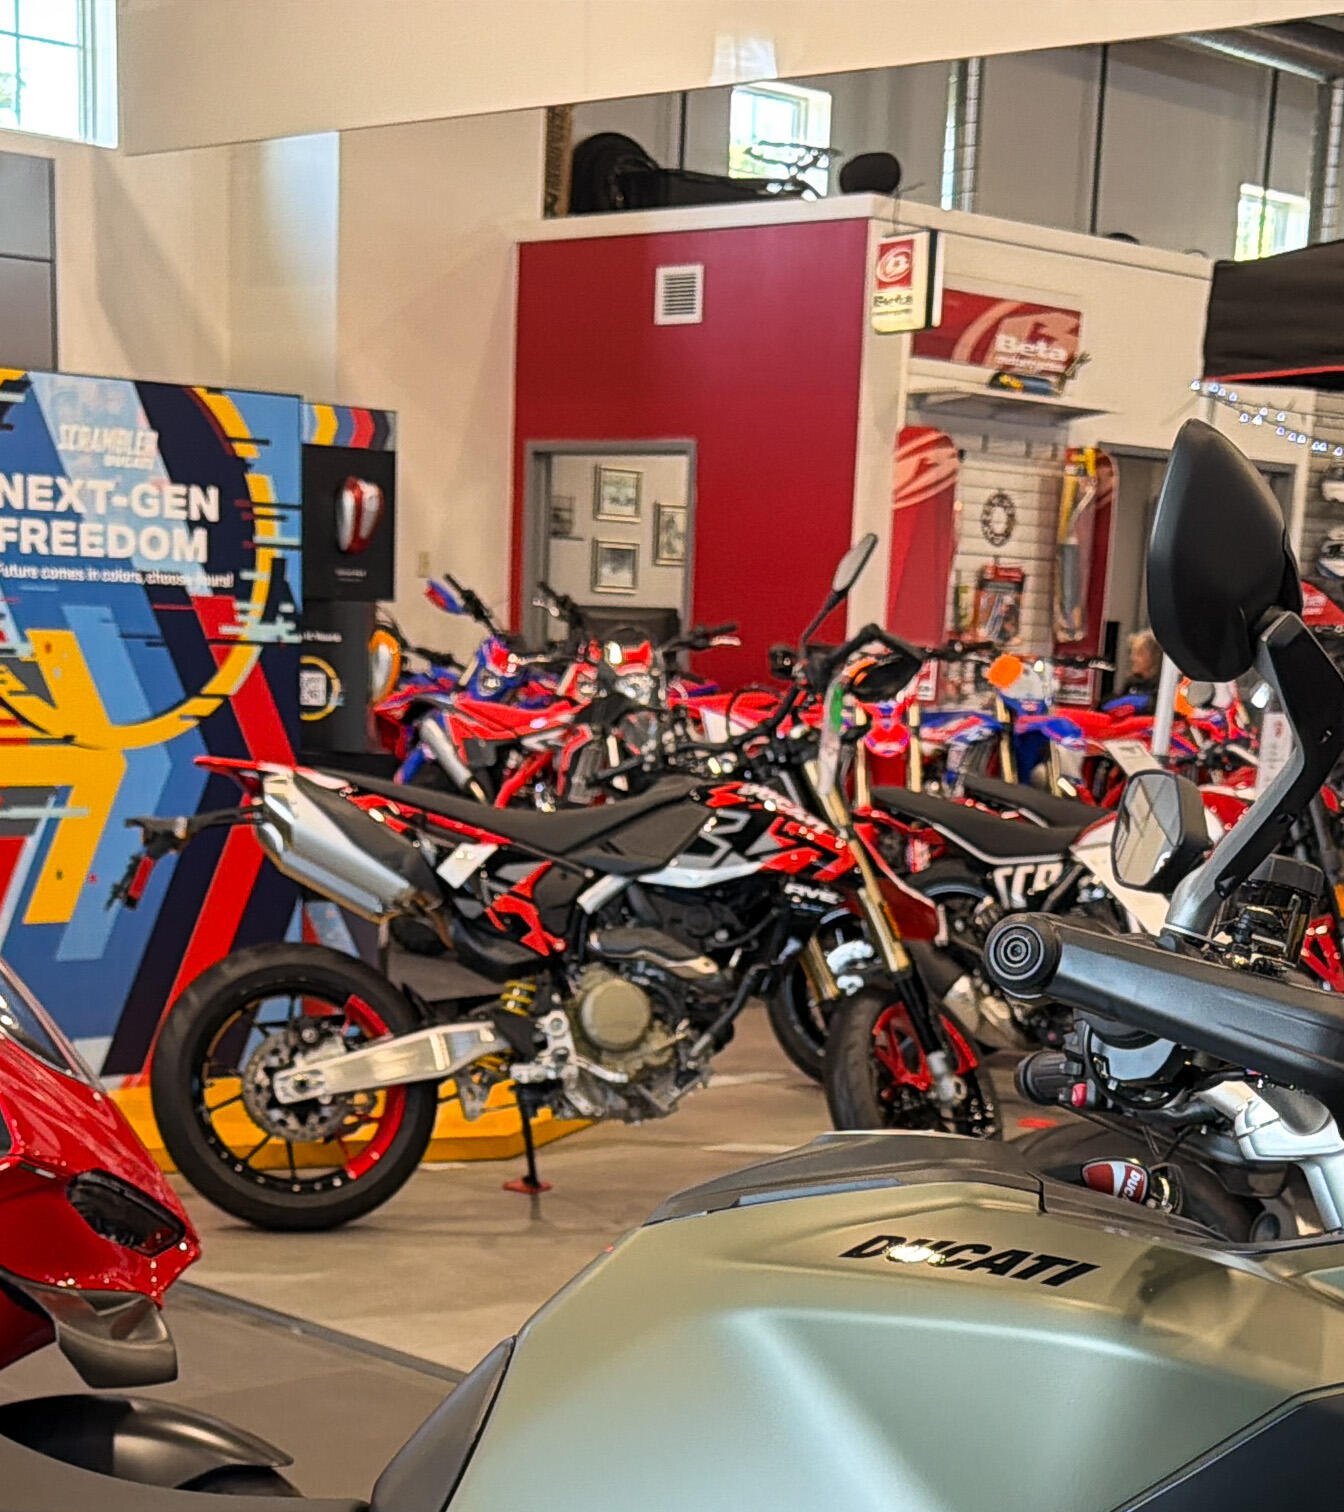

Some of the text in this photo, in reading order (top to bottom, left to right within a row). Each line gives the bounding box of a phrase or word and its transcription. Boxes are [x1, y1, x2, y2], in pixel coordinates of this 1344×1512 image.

[993, 334, 1068, 362] Beta
[41, 567, 85, 581] comes
[1121, 1170, 1142, 1199] DUC
